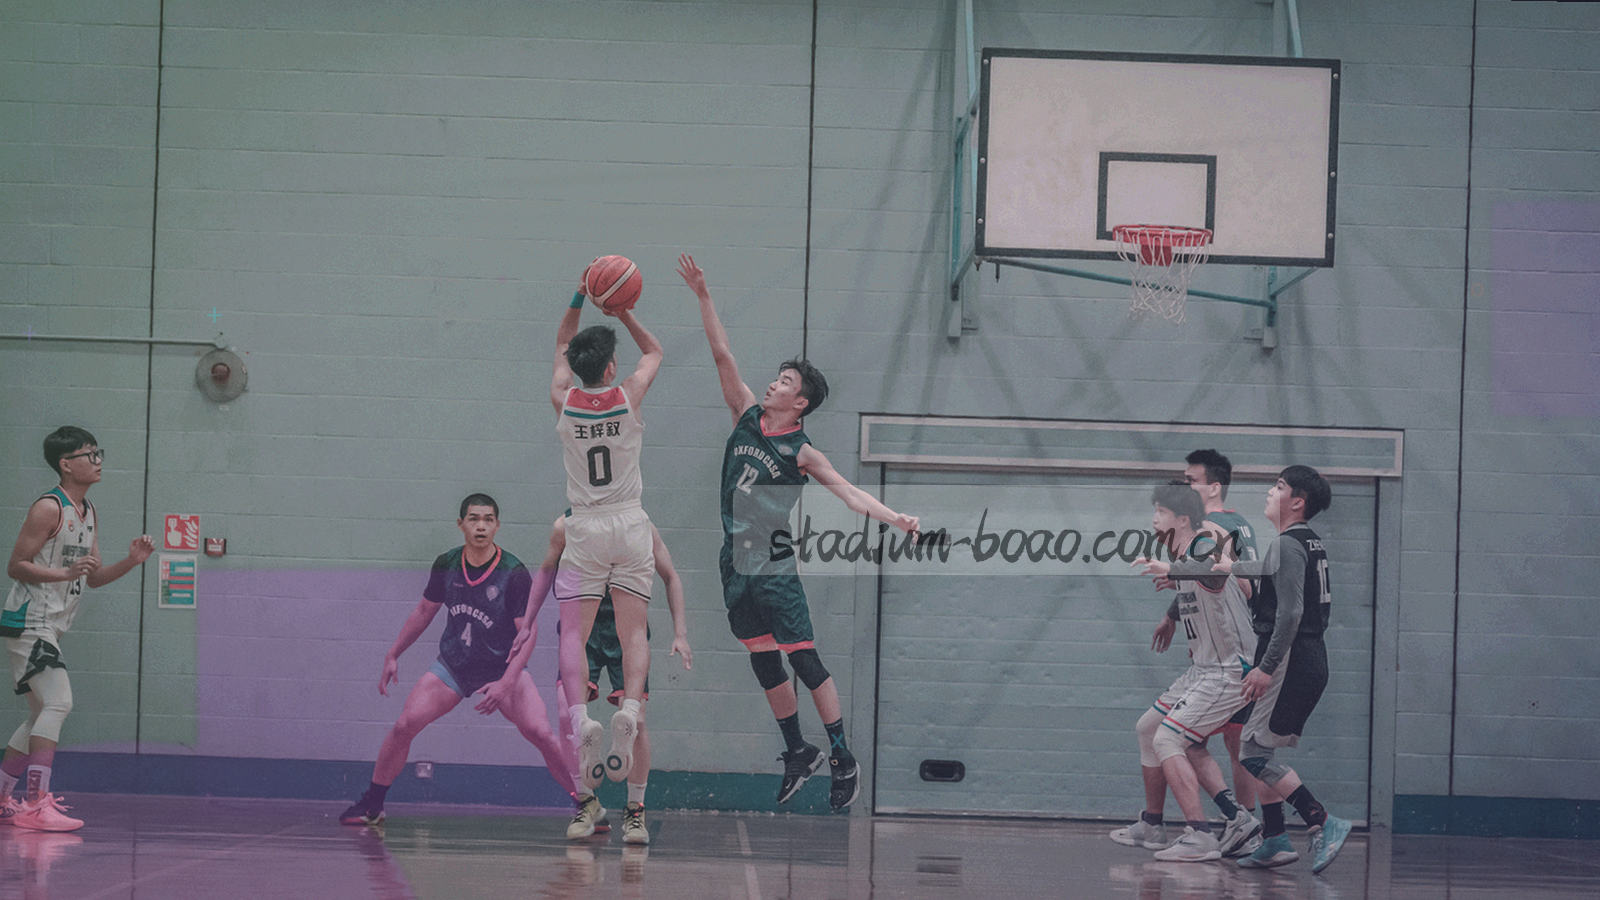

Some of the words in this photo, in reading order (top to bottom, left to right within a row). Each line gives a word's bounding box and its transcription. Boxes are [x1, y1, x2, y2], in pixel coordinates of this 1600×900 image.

[587, 445, 612, 487] 0
[736, 463, 759, 494] 12
[461, 622, 472, 647] 4
